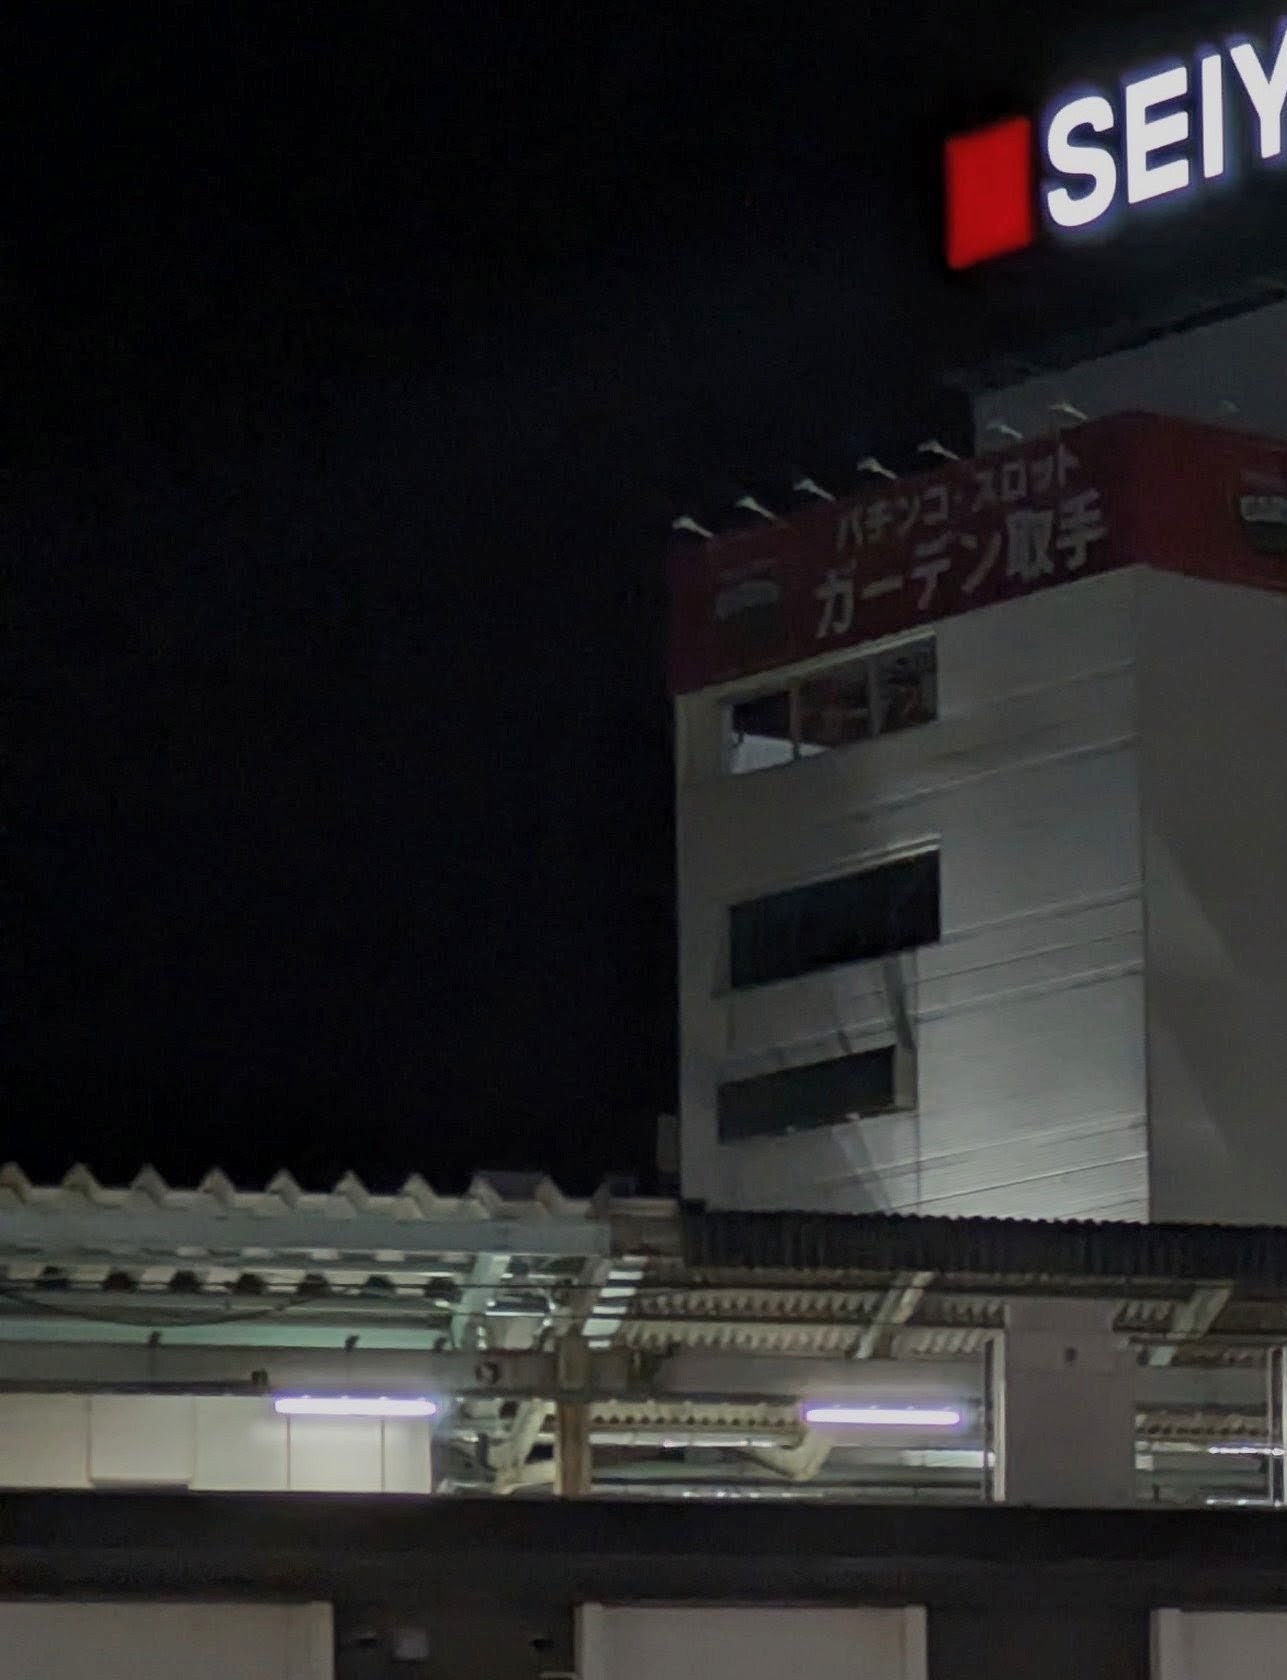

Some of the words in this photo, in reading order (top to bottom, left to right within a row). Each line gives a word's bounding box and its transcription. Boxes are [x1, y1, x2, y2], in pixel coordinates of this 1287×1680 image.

[814, 488, 1108, 640] ガーデン取手
